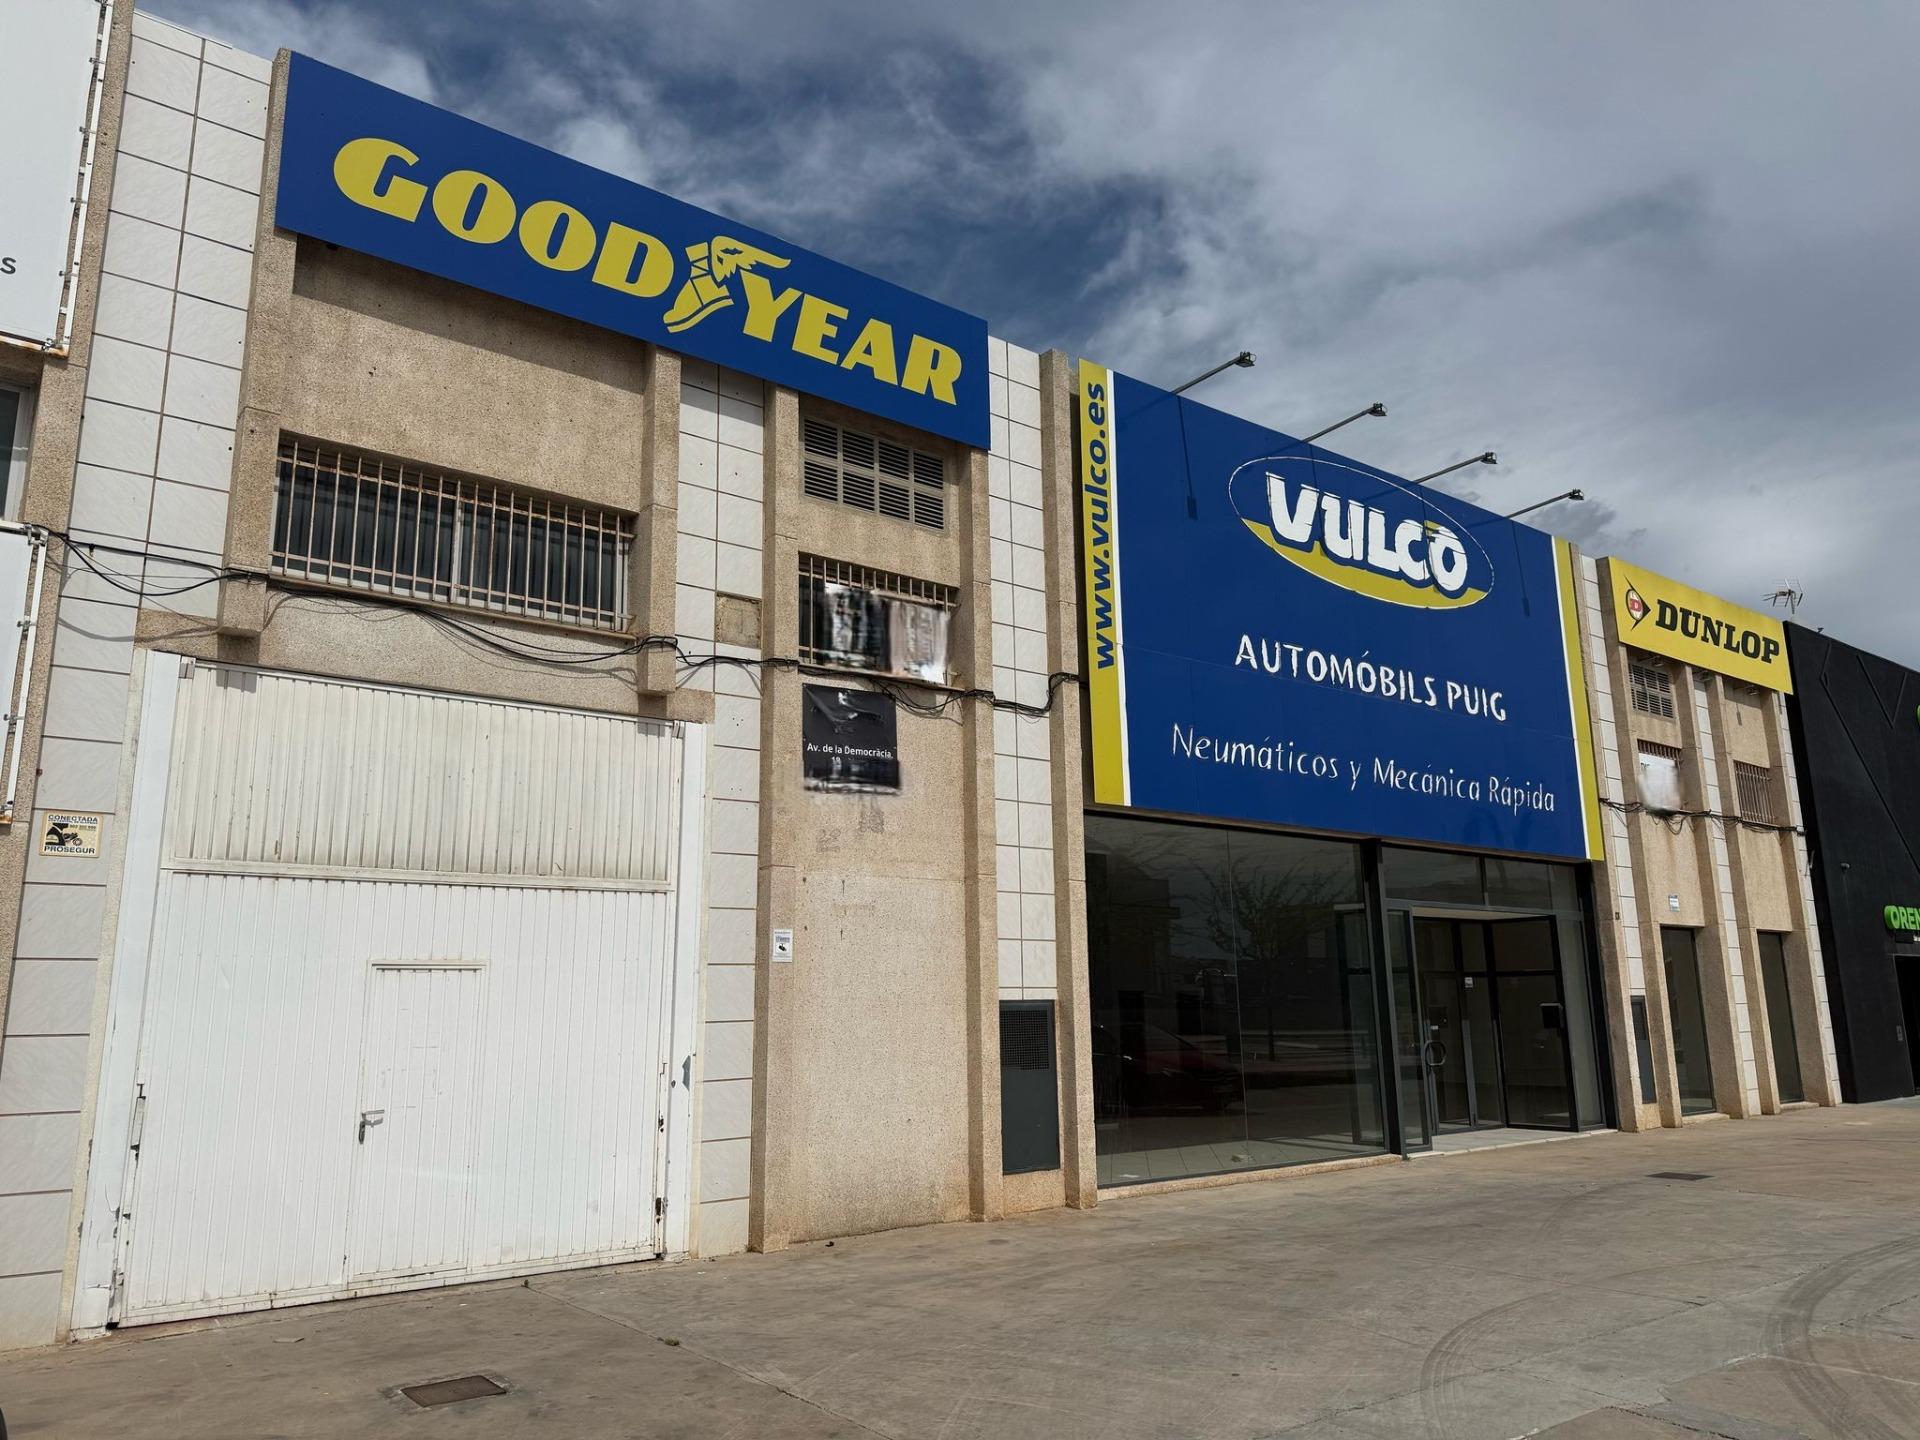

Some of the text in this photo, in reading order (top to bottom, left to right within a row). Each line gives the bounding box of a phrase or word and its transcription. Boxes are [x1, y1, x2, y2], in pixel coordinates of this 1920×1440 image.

[1084, 382, 1115, 669] www.vulco.es
[1265, 471, 1468, 592] VULCO
[1655, 598, 1780, 664] DUNLOP
[1235, 634, 1506, 721] AUTOMÓBILS PUIG
[807, 743, 820, 752] Av.
[822, 744, 834, 753] de
[835, 745, 843, 754] la
[1173, 723, 1555, 816] Neumáticos y Mecánica Rápida
[44, 845, 95, 854] PROSEGUR
